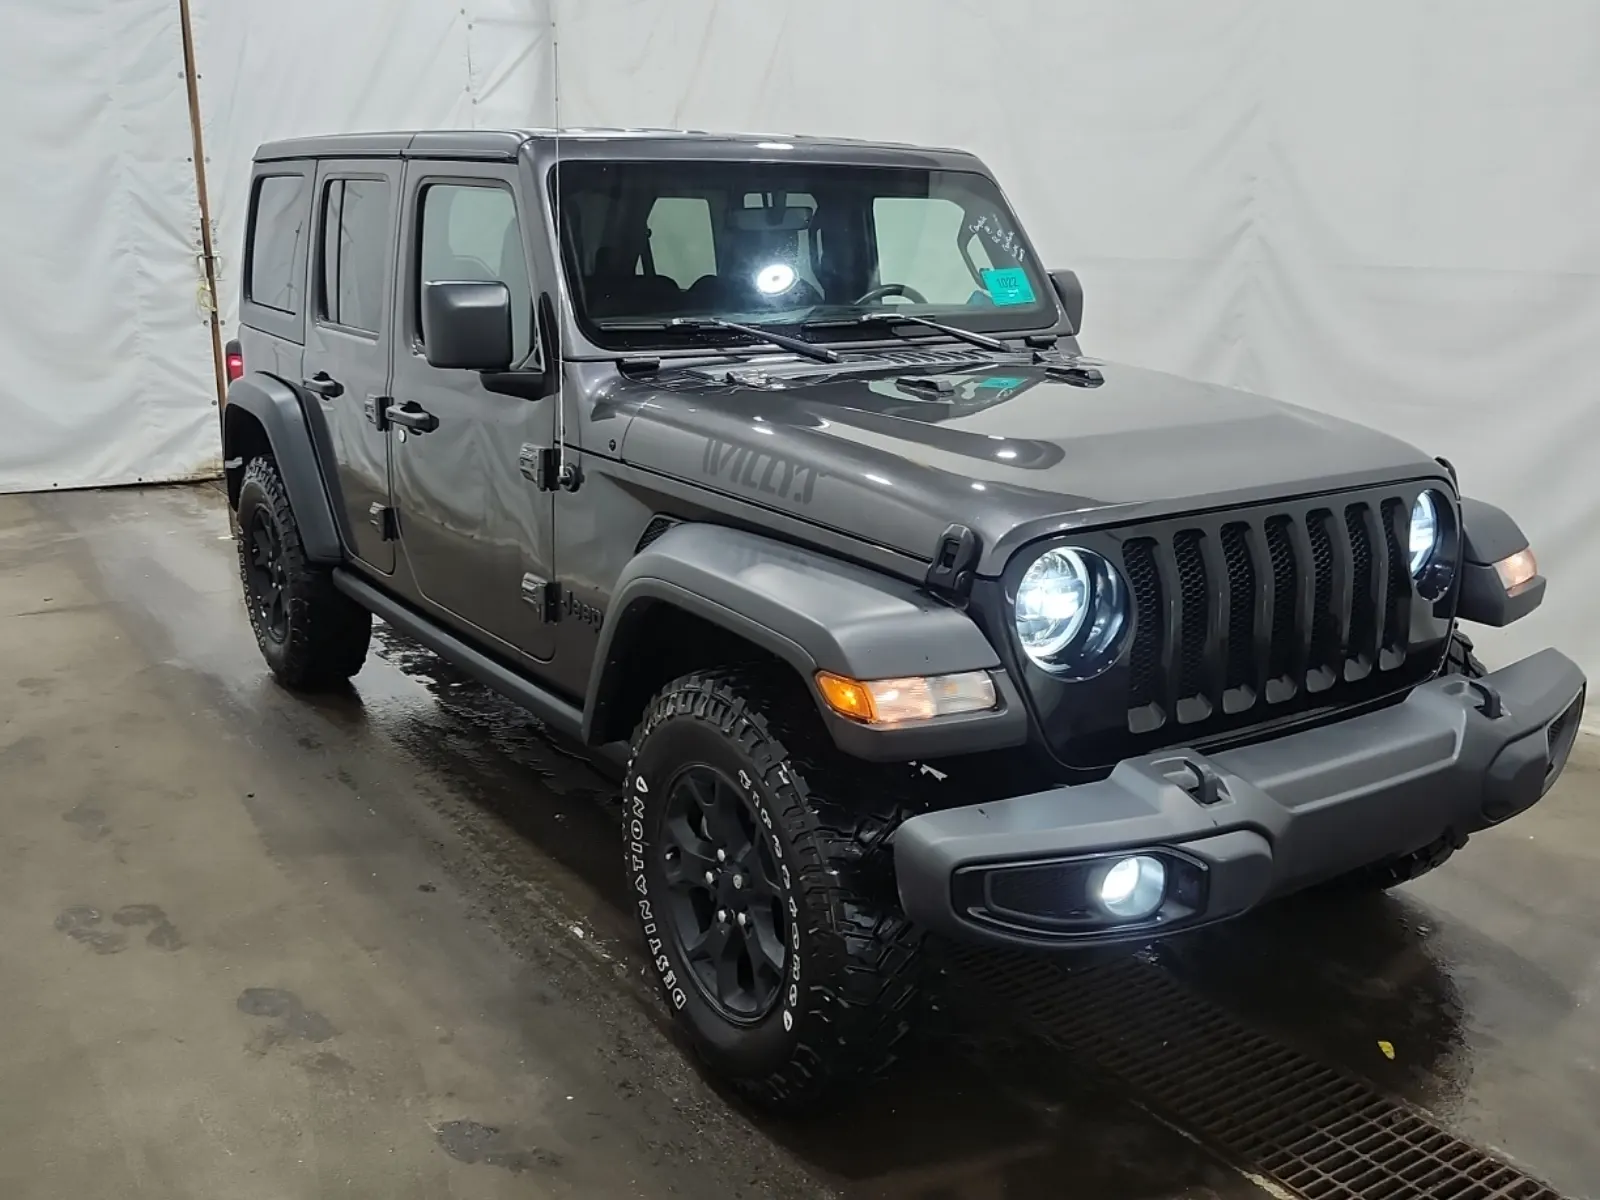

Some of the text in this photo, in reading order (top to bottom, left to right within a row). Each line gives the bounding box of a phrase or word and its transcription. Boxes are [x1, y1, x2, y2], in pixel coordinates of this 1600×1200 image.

[997, 276, 1019, 289] 1022
[560, 590, 605, 633] Jeep
[631, 795, 687, 1010] DESTINATION
